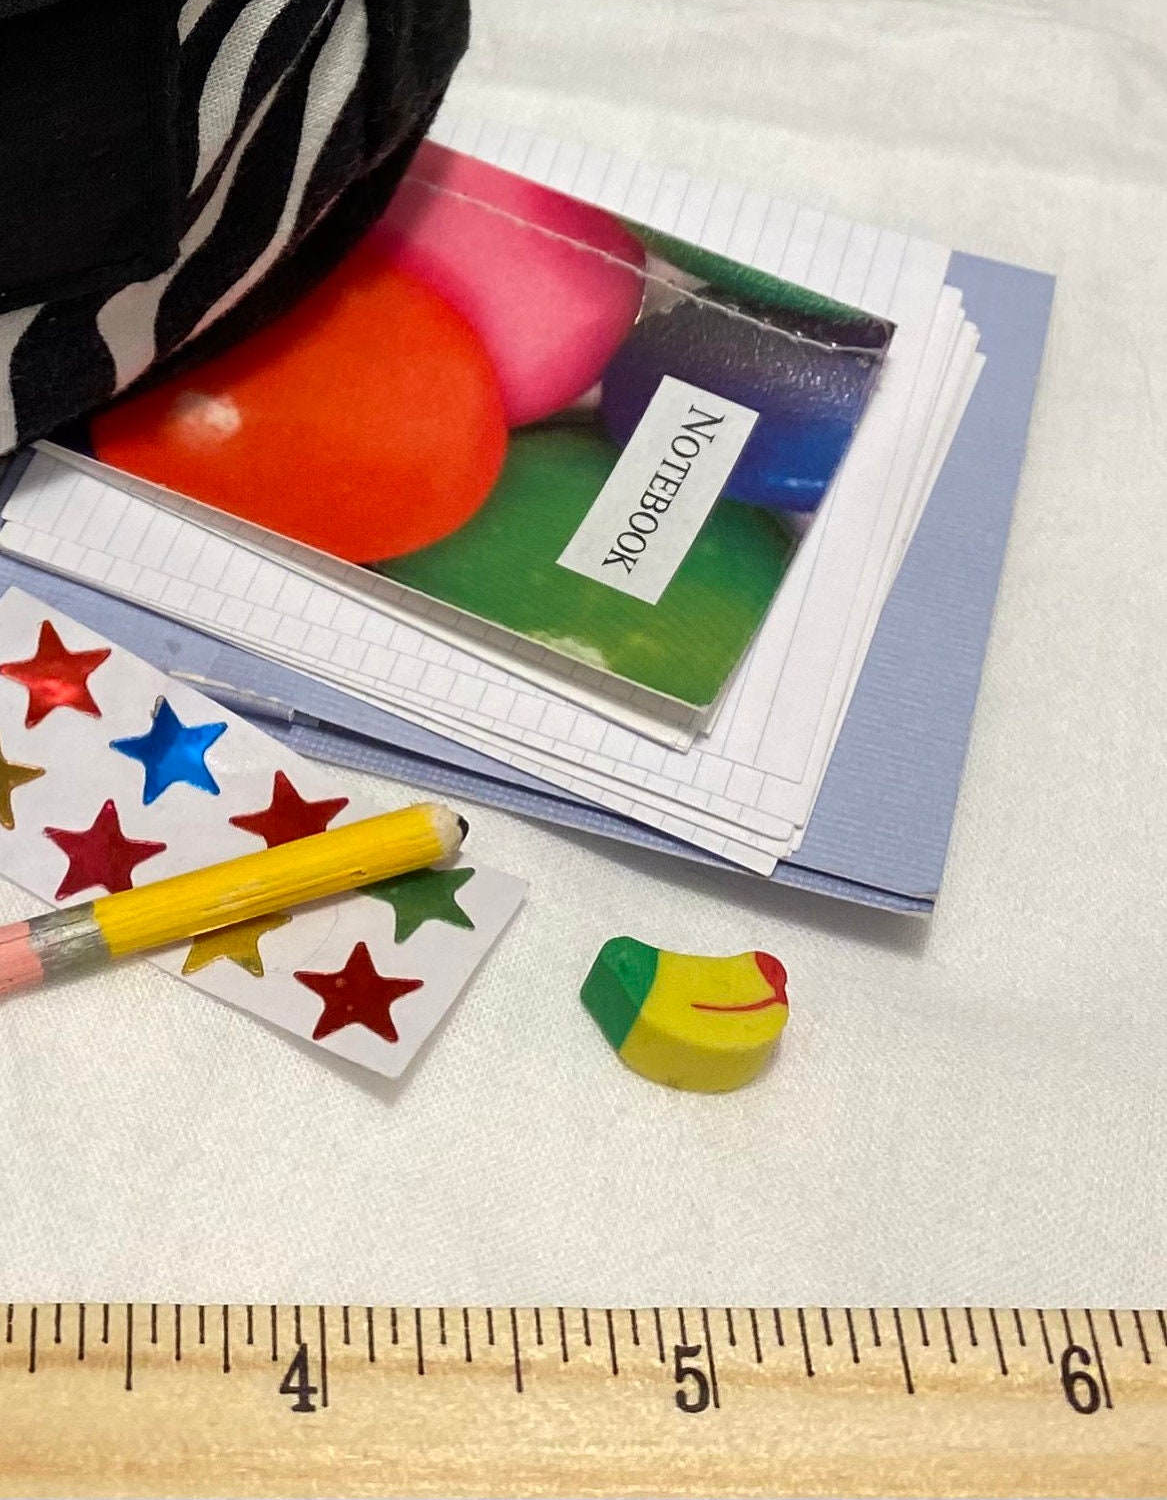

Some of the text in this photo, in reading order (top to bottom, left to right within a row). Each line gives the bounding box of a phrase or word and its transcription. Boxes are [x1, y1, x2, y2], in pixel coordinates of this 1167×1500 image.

[601, 403, 726, 575] NOTEBOOK
[279, 1342, 318, 1412] 4
[674, 1344, 710, 1413] 5
[1060, 1344, 1100, 1415] 6
